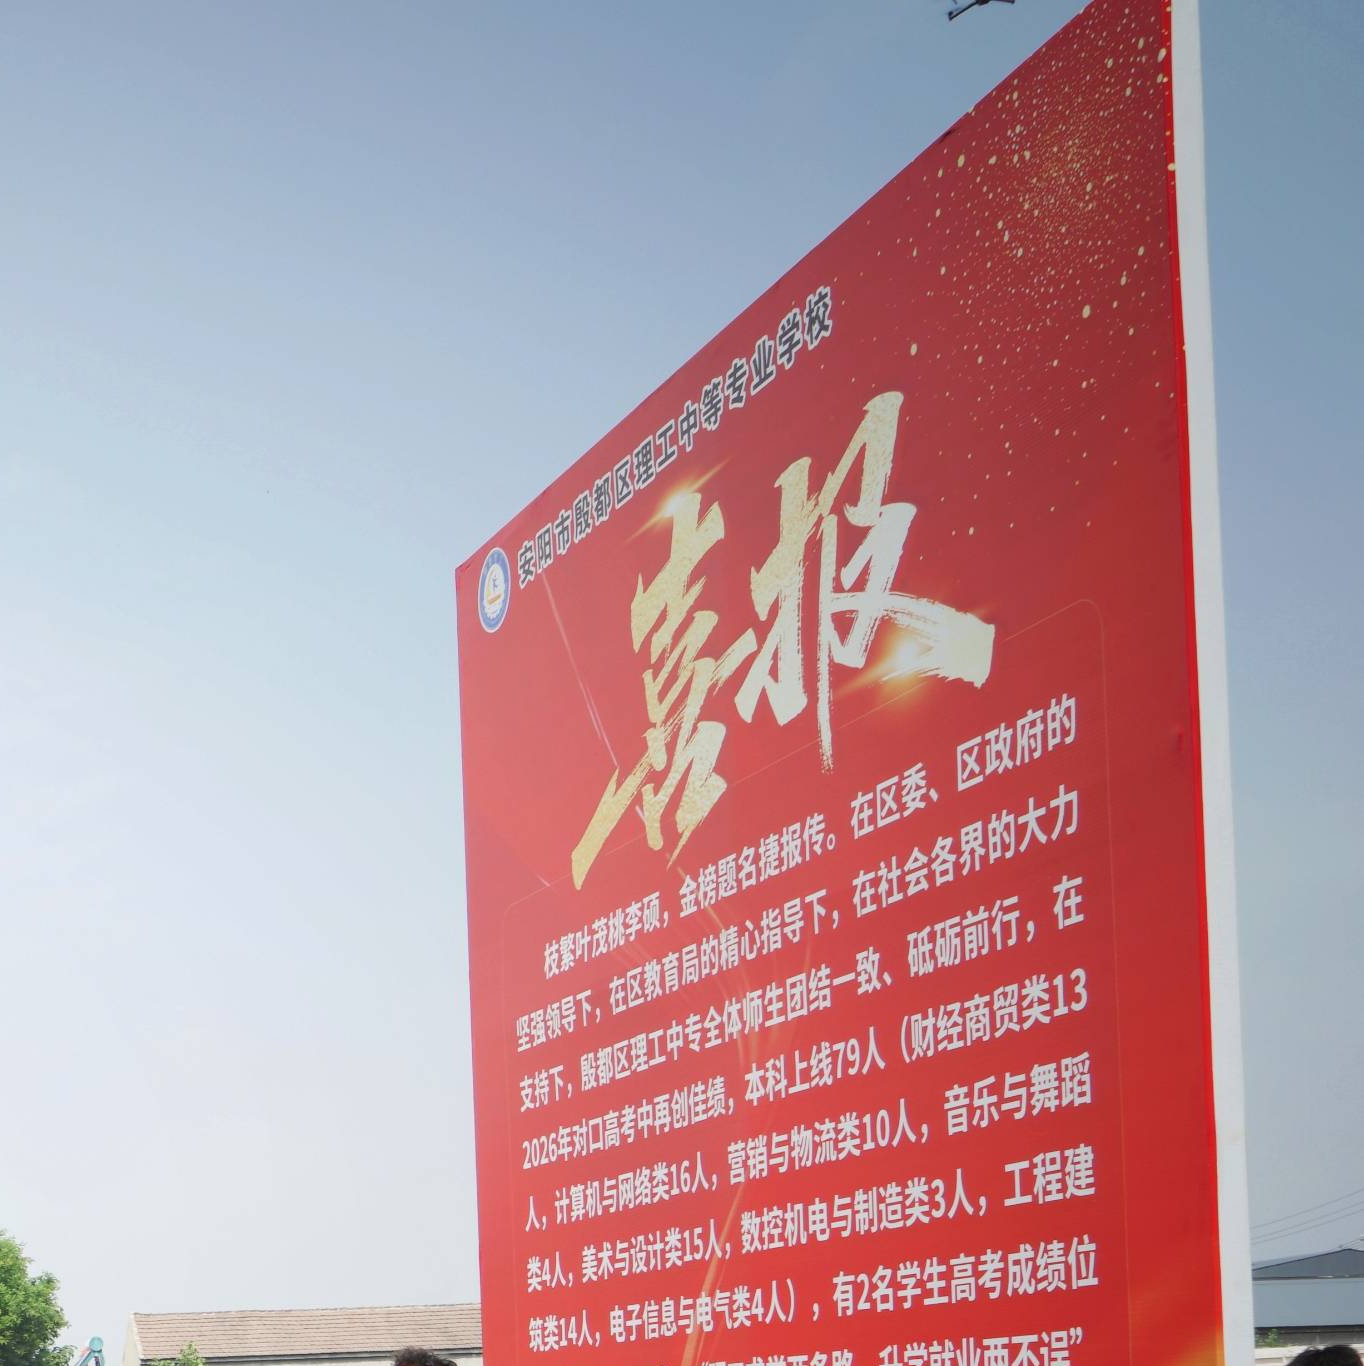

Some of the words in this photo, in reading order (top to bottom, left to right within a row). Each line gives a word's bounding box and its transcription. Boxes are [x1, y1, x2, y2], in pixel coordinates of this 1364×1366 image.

[516, 285, 834, 589] 安阳市殷都区理工中等专业学校
[571, 391, 995, 891] 喜报
[517, 786, 1077, 1050] 坚强领导下，在区教育局的精心指导下，在社会各界的大力
[542, 696, 1075, 976] 枝繁叶茂桃李硕，金榜题名捷报传。在区委、区政府的
[520, 877, 1082, 1110] 支持下，殷都区理工中专全体师生团结一致、砥砺前行，在
